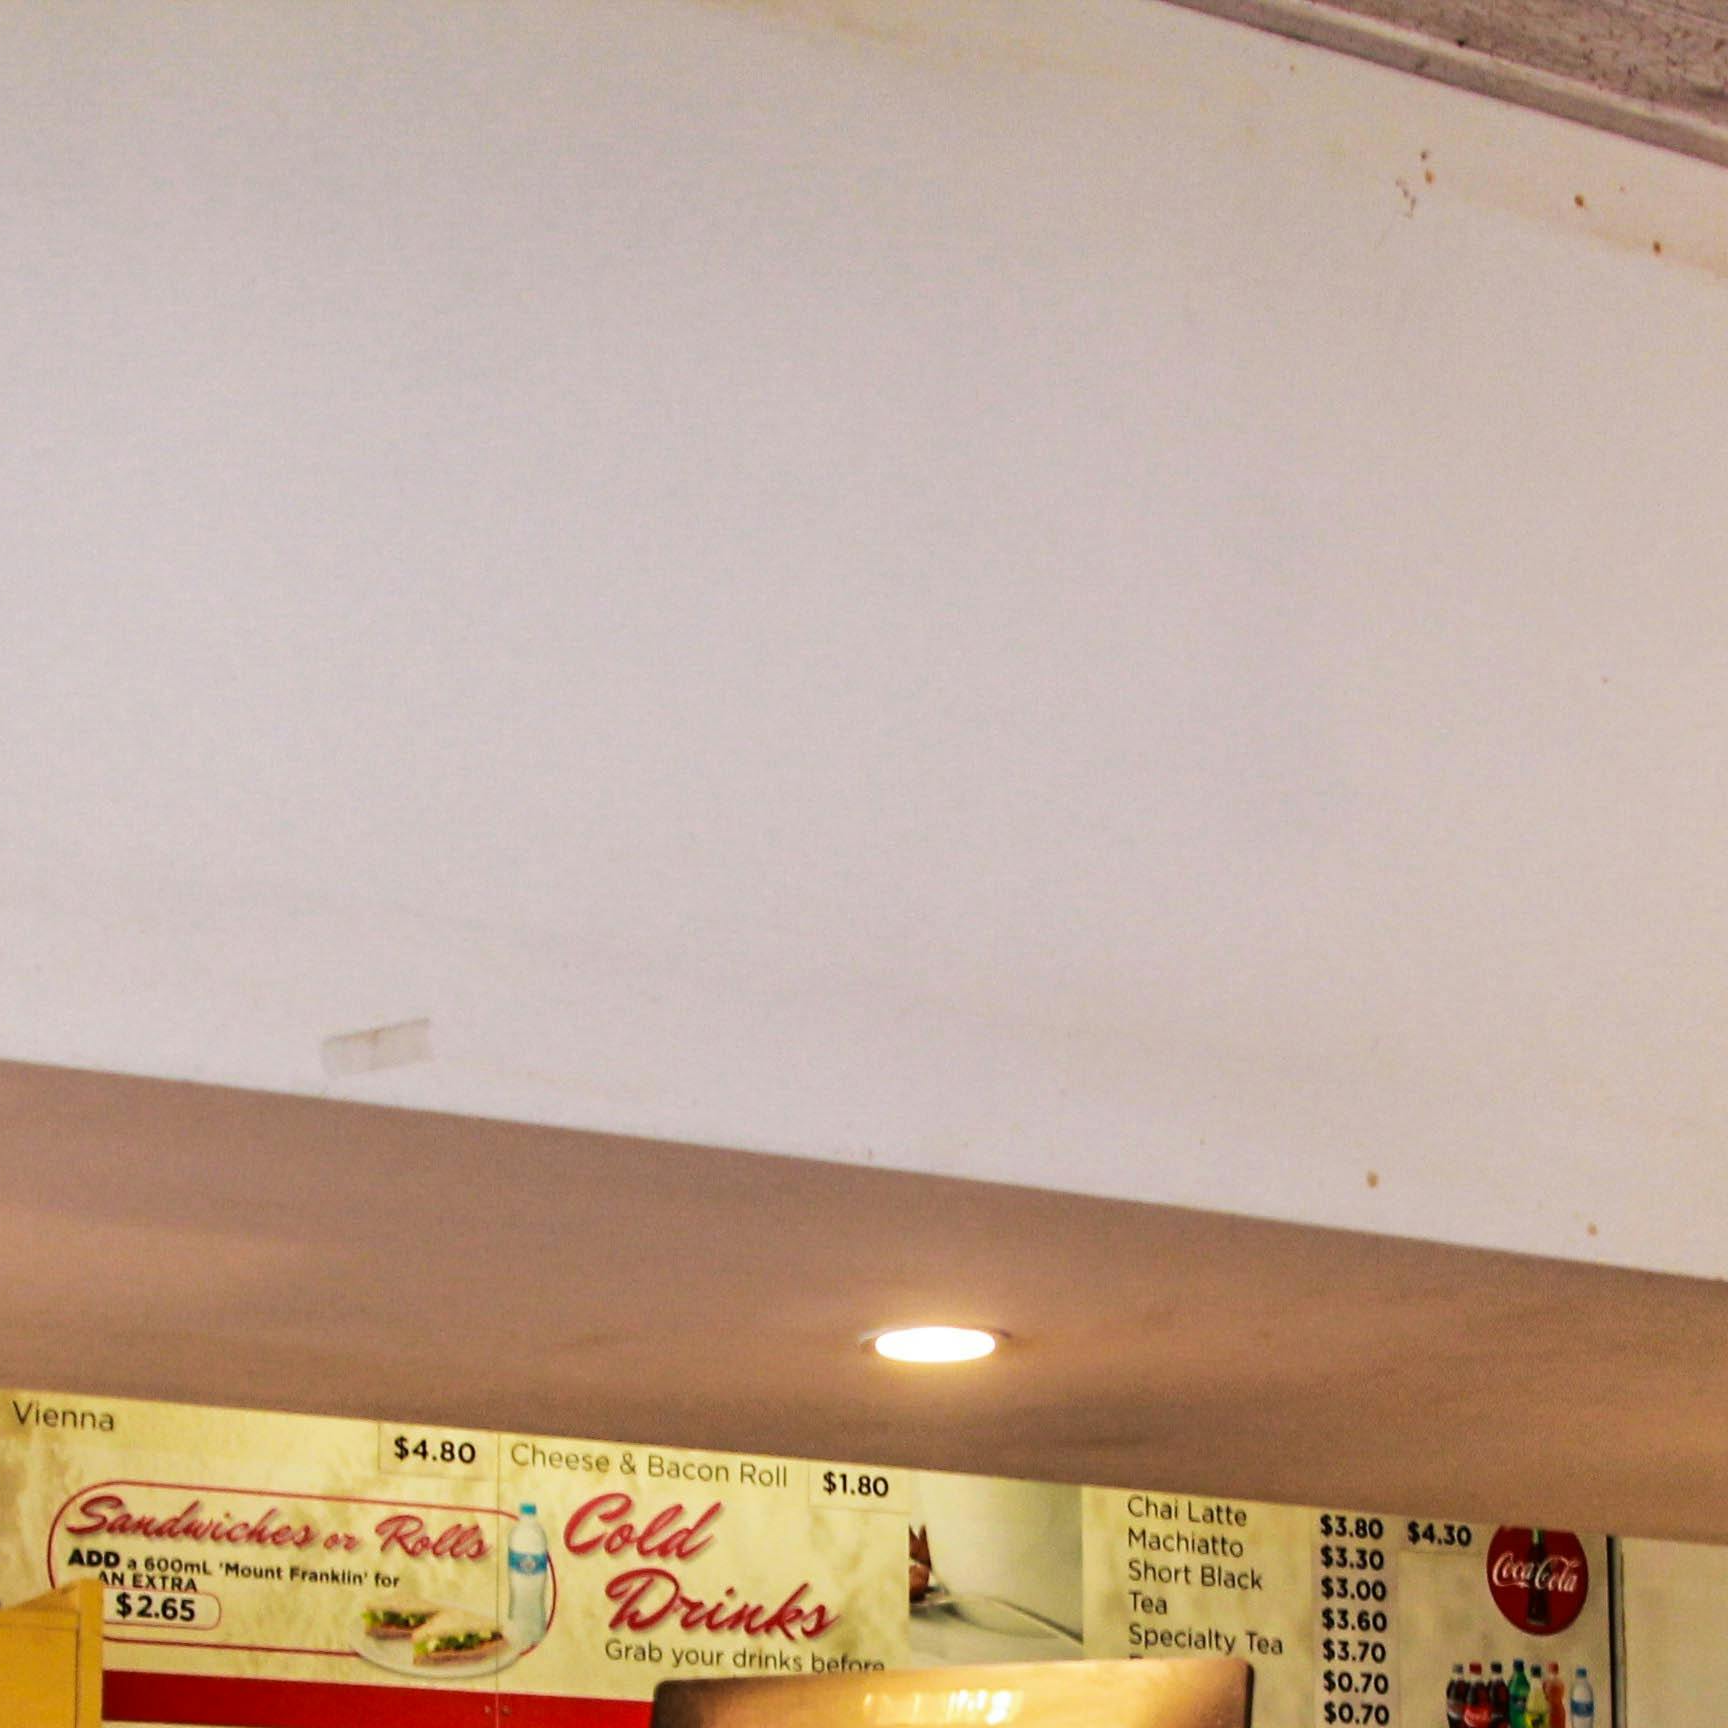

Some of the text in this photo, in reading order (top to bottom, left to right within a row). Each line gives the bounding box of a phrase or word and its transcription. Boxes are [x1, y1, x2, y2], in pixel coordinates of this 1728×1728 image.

[12, 1401, 116, 1432] Vienna
[393, 1434, 477, 1466] $4.80
[510, 1443, 789, 1488] Cheese & Bacon Roll
[822, 1471, 890, 1499] $1.80
[66, 1494, 492, 1562] Sandwiches or Rolls
[563, 1493, 724, 1561] Cold
[1127, 1496, 1248, 1529] Chai Latte
[1320, 1514, 1385, 1541] $3.80
[1128, 1528, 1245, 1559] Machiatto
[1407, 1518, 1472, 1549] $4.30
[68, 1547, 401, 1589] ADD a 600mL 'Mount Franklin' for
[1320, 1545, 1385, 1572] $3.30
[98, 1570, 198, 1594] AN EXTRA
[1128, 1560, 1263, 1592] Short Black
[1320, 1576, 1387, 1603] $3.00
[115, 1591, 196, 1623] $2.65
[605, 1568, 839, 1642] Drinks
[1128, 1592, 1168, 1616] Tea
[1321, 1607, 1388, 1635] $3.60
[1128, 1622, 1285, 1657] Specialty Tea
[1322, 1638, 1387, 1665] $3.70
[605, 1639, 886, 1674] Grab your drinks before
[1323, 1670, 1390, 1697] $0.70
[1324, 1701, 1390, 1728] $0.70
